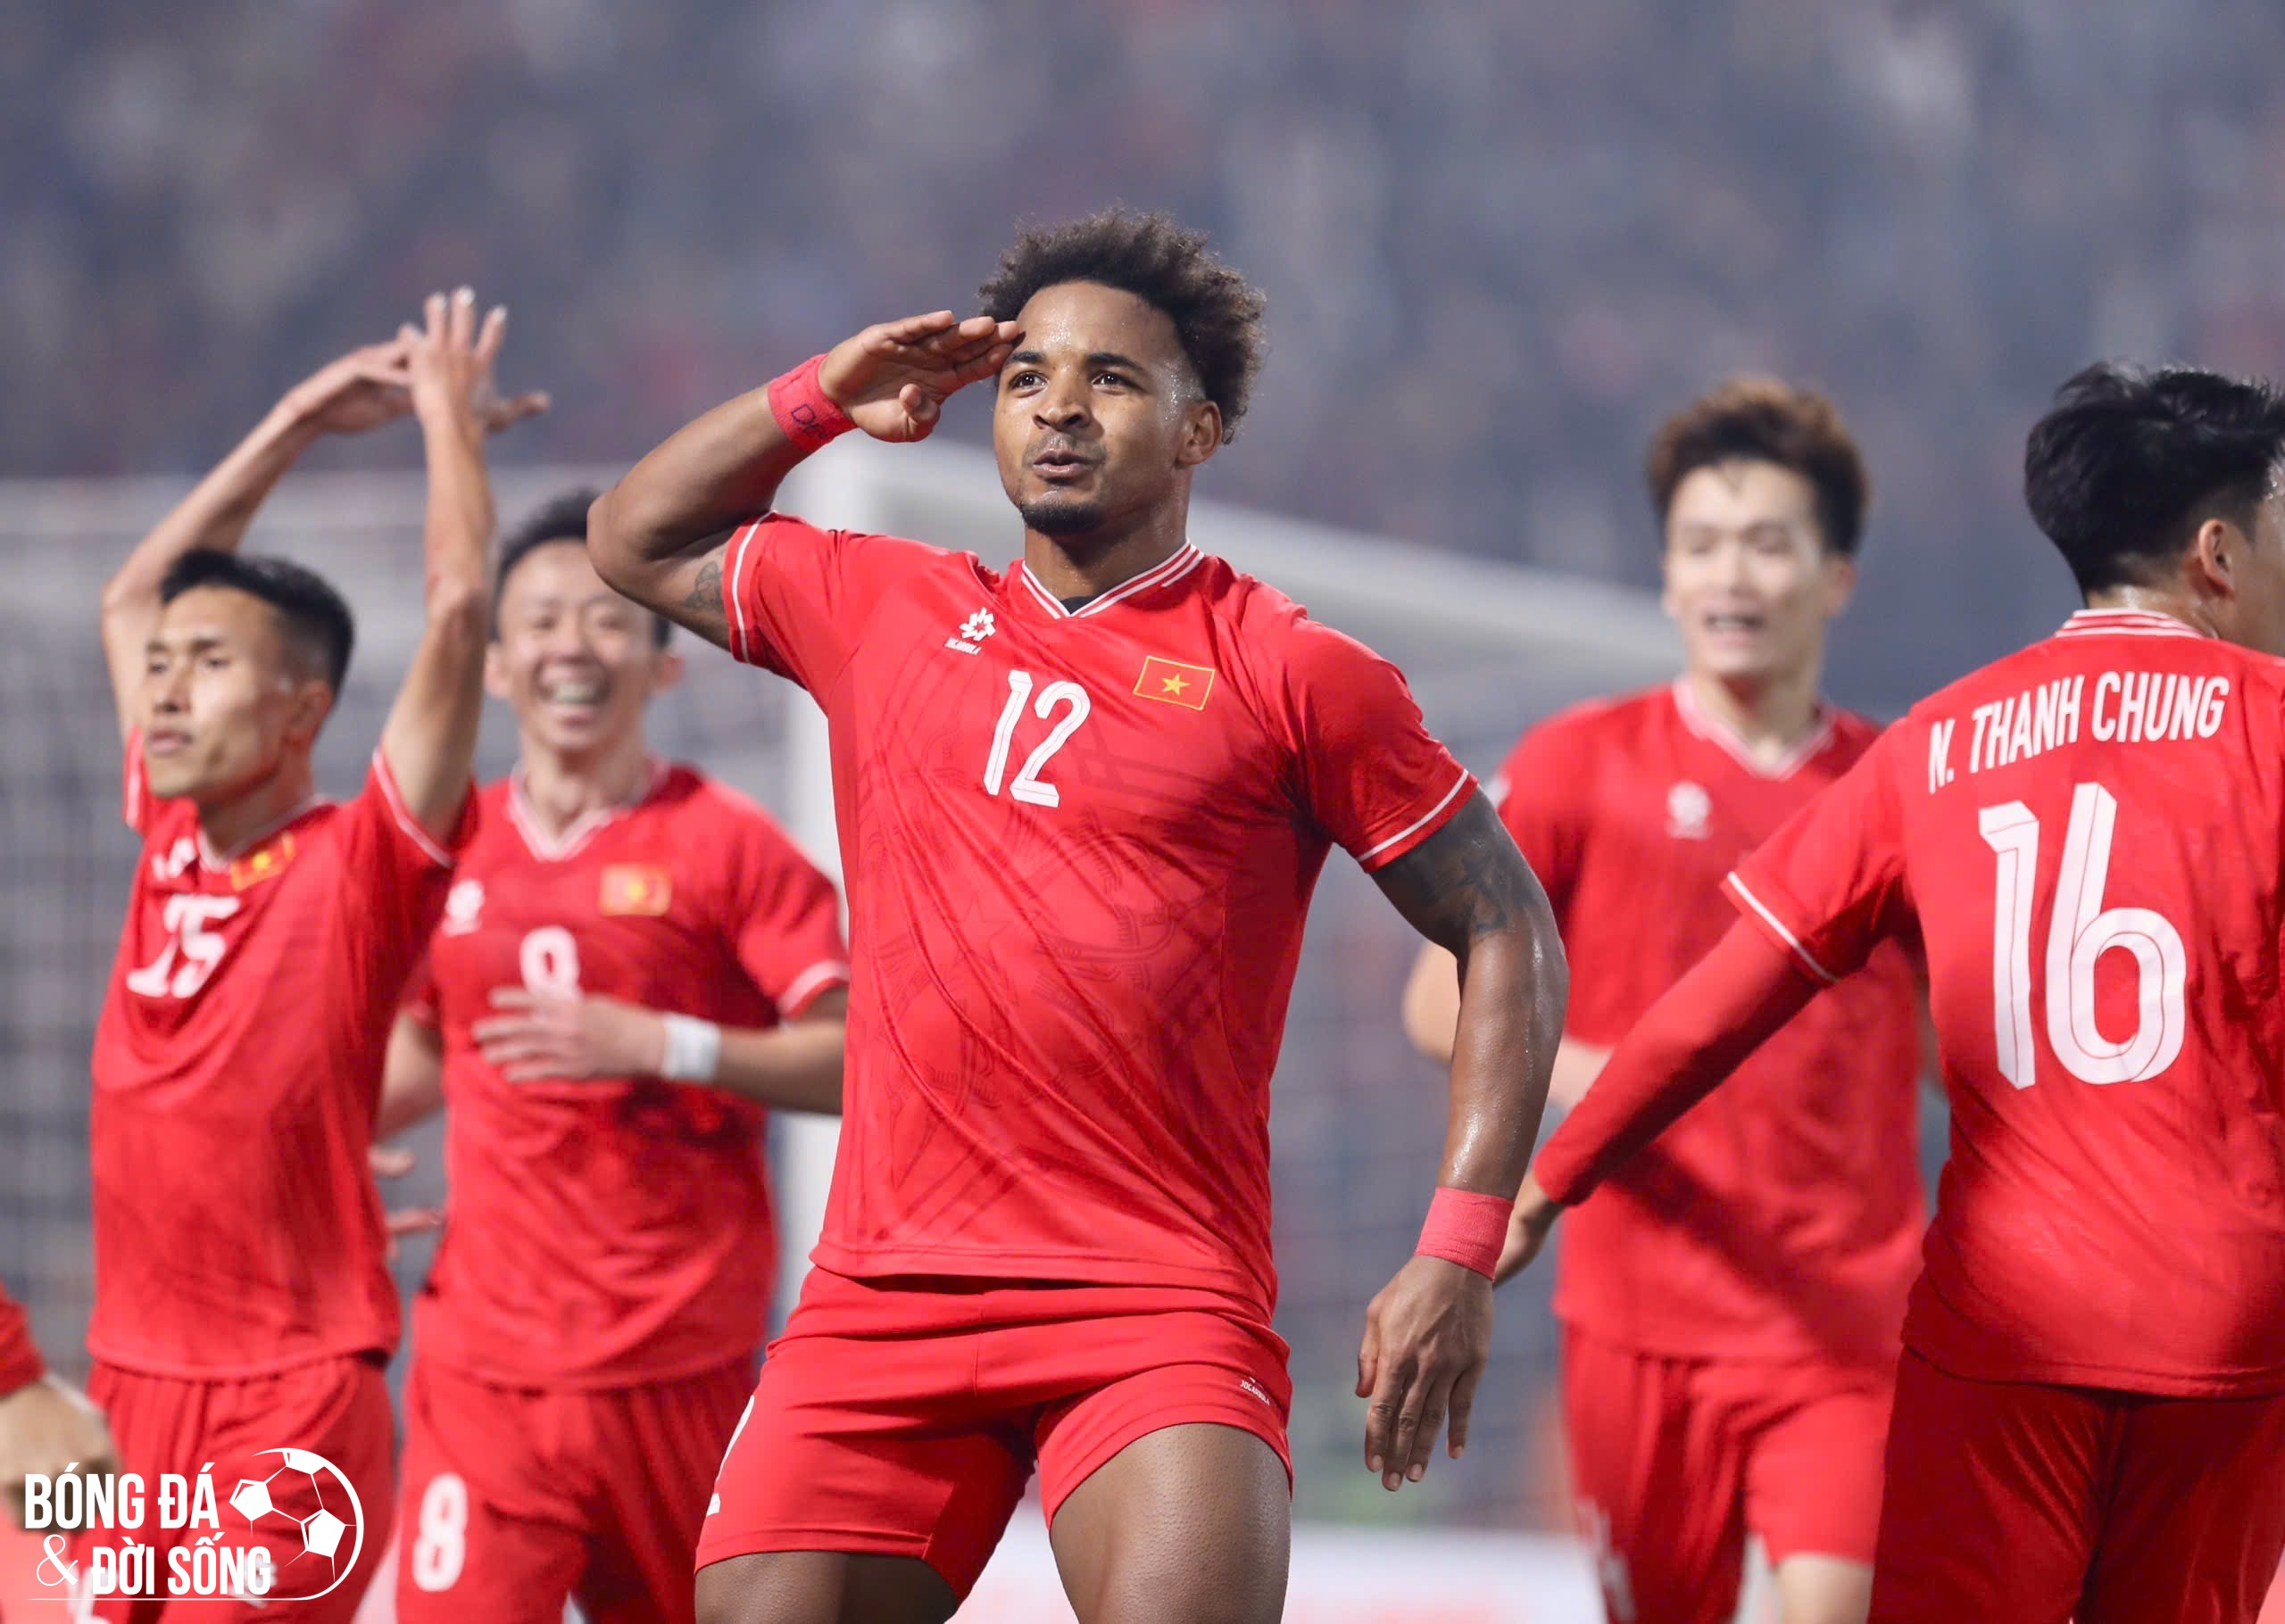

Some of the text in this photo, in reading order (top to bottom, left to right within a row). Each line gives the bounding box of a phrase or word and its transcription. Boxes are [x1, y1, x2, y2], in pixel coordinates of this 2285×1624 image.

[983, 668, 1092, 808] 12
[1927, 670, 2230, 795] N. THANH CHUNG
[125, 893, 241, 999] 15
[1977, 781, 2187, 1090] 16
[411, 1471, 469, 1593] 8
